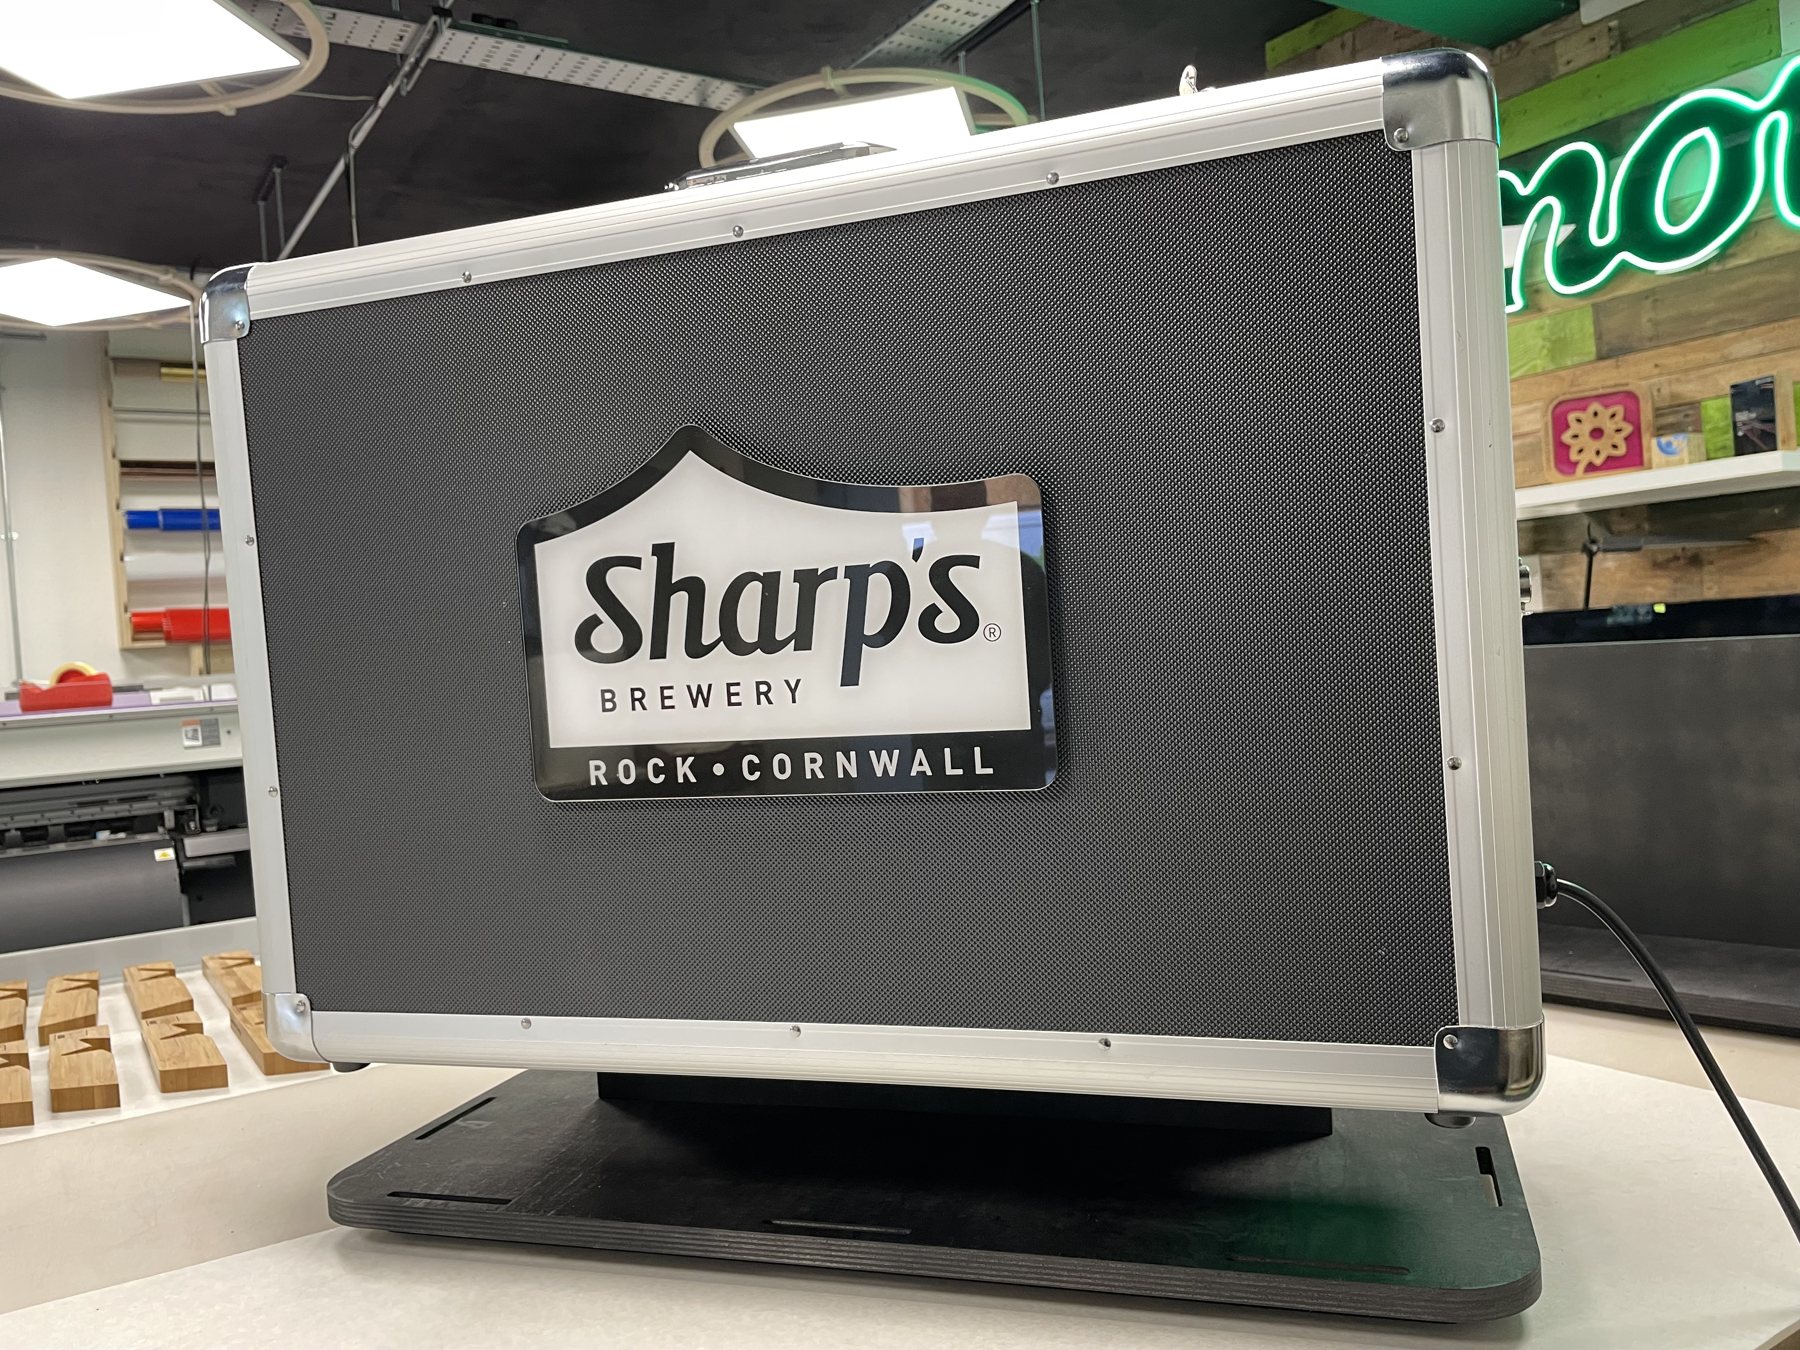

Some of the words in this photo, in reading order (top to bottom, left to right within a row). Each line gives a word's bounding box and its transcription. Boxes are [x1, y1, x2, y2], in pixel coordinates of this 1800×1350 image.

[600, 679, 803, 713] BREWERY
[588, 756, 697, 786] ROCK
[741, 746, 994, 781] CORNWALL
